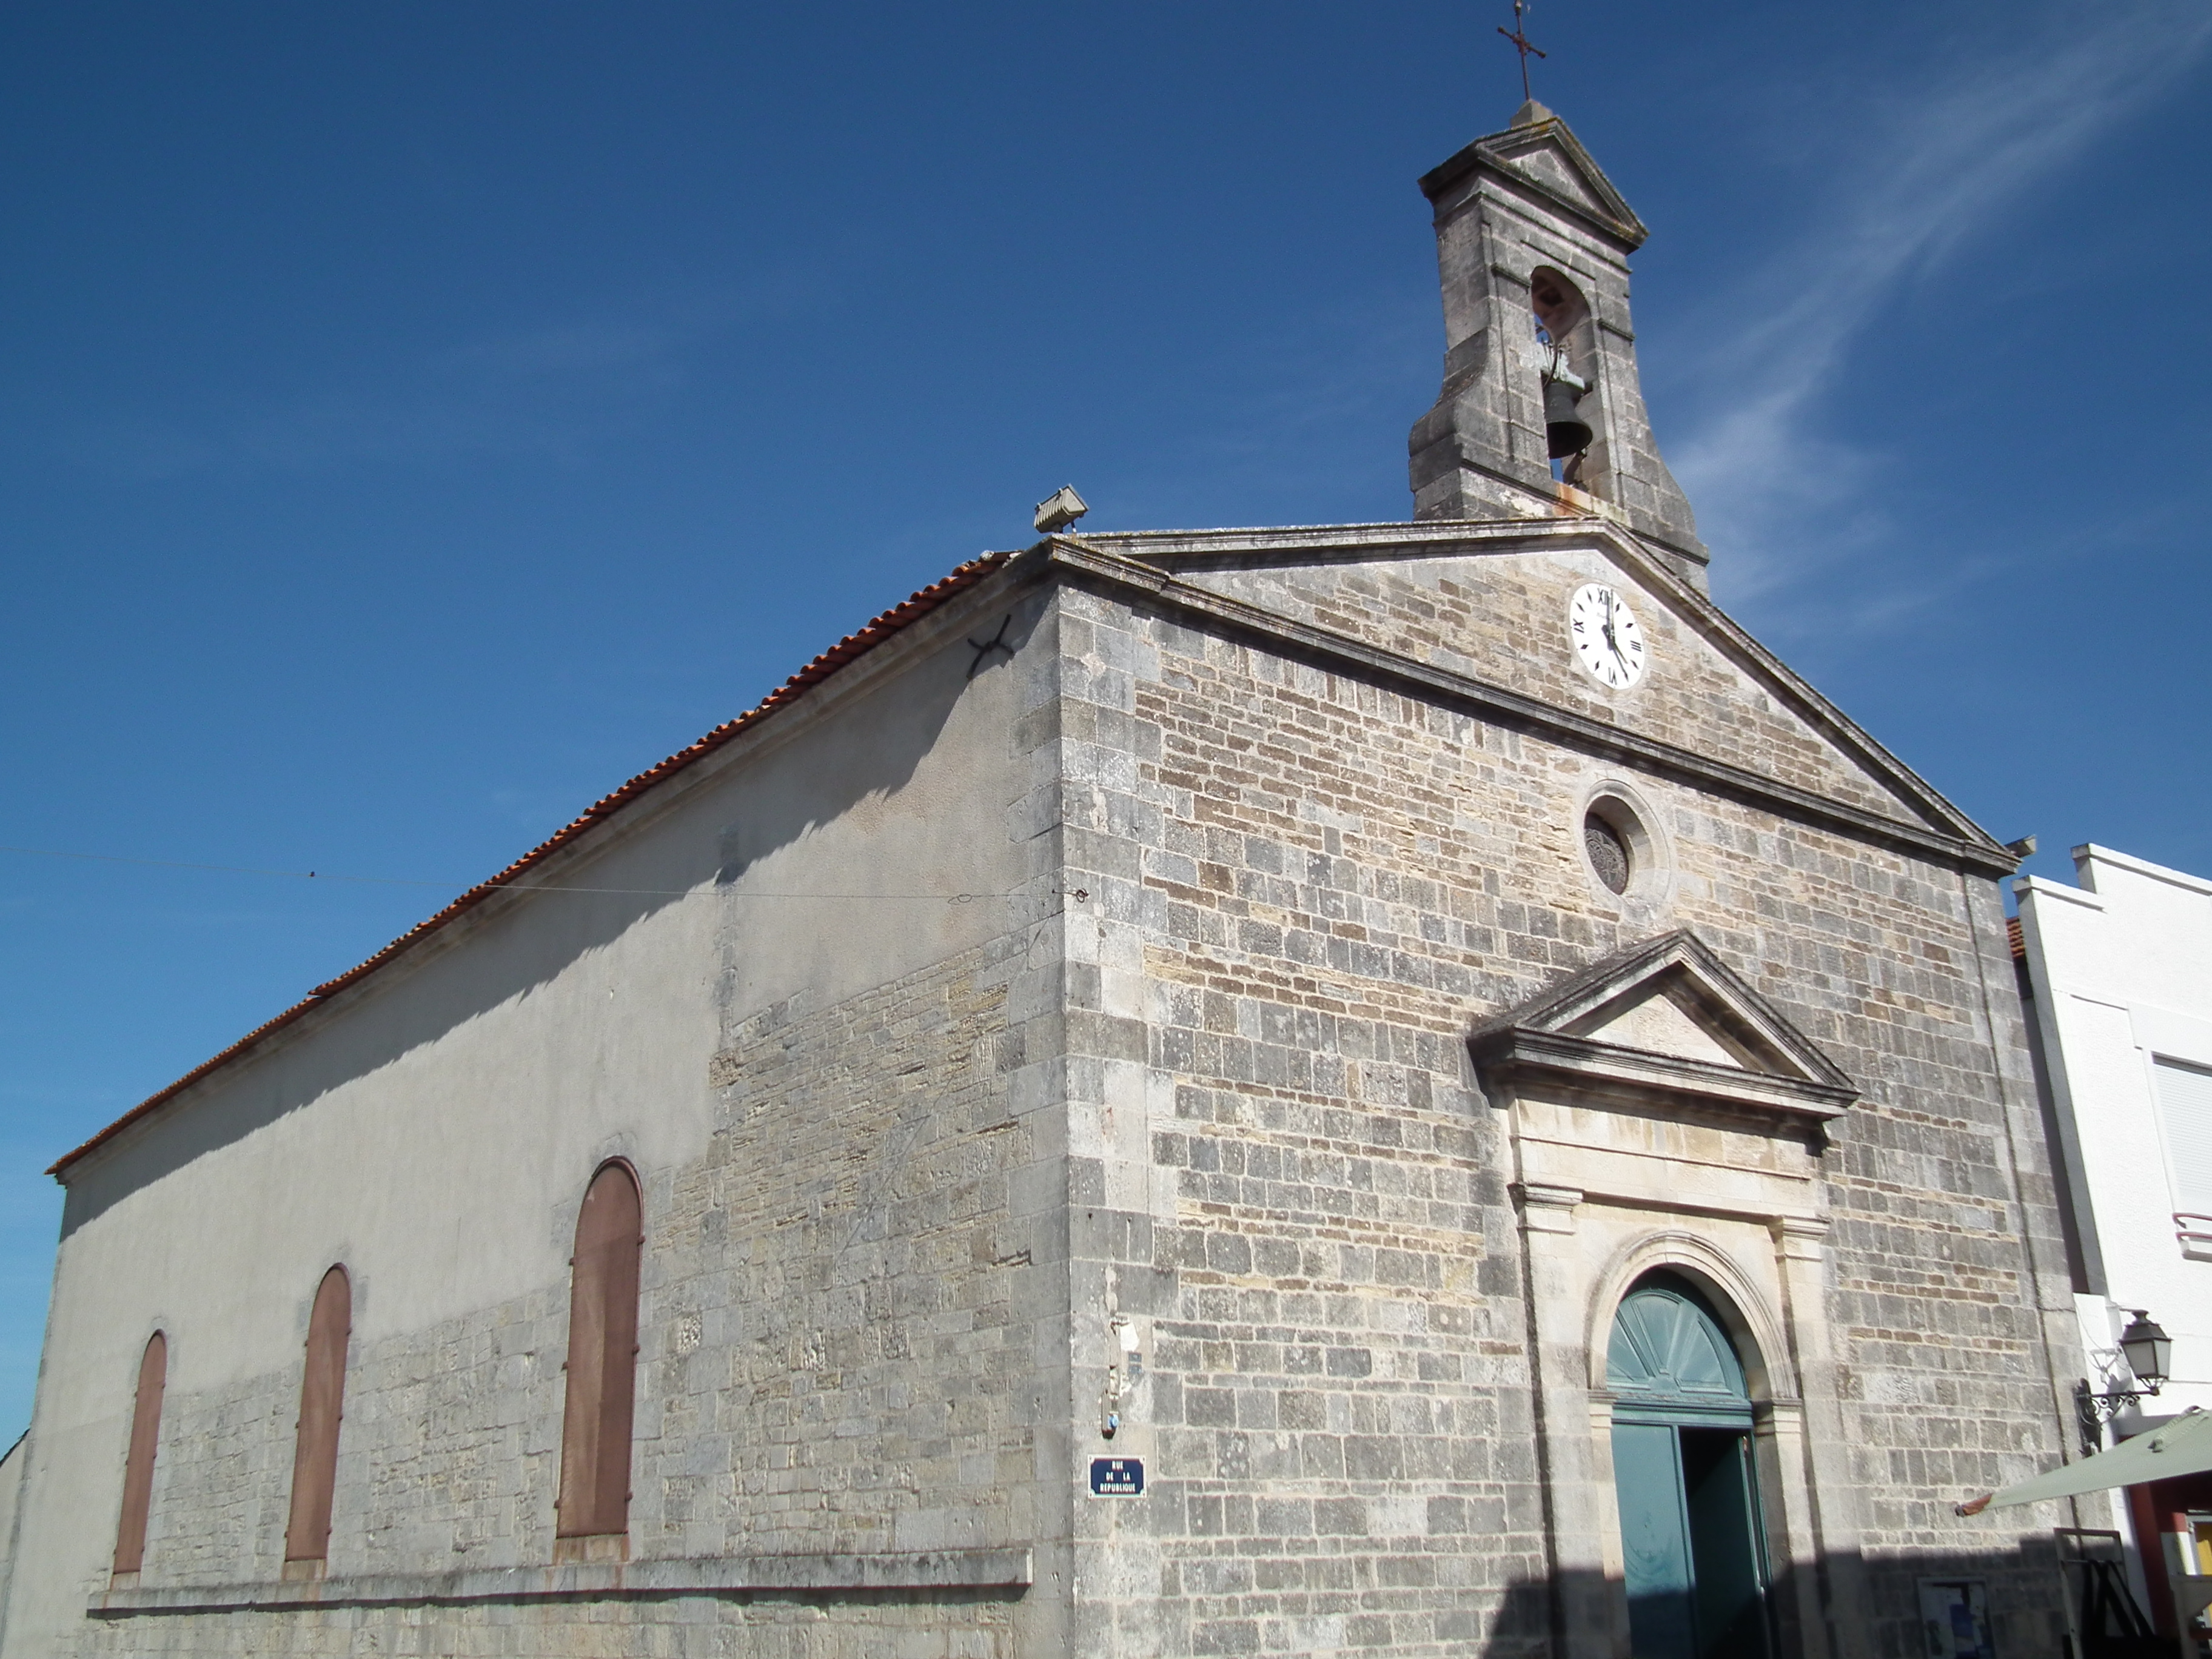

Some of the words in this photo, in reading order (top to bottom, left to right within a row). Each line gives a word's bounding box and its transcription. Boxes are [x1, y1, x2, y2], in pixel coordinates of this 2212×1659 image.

[1573, 618, 1584, 633] IX
[1631, 640, 1642, 652] III
[1111, 1460, 1124, 1470] RUE
[1106, 1472, 1114, 1481] DE
[1123, 1472, 1131, 1481] LA
[1099, 1483, 1136, 1493] REPUBLIQUE
